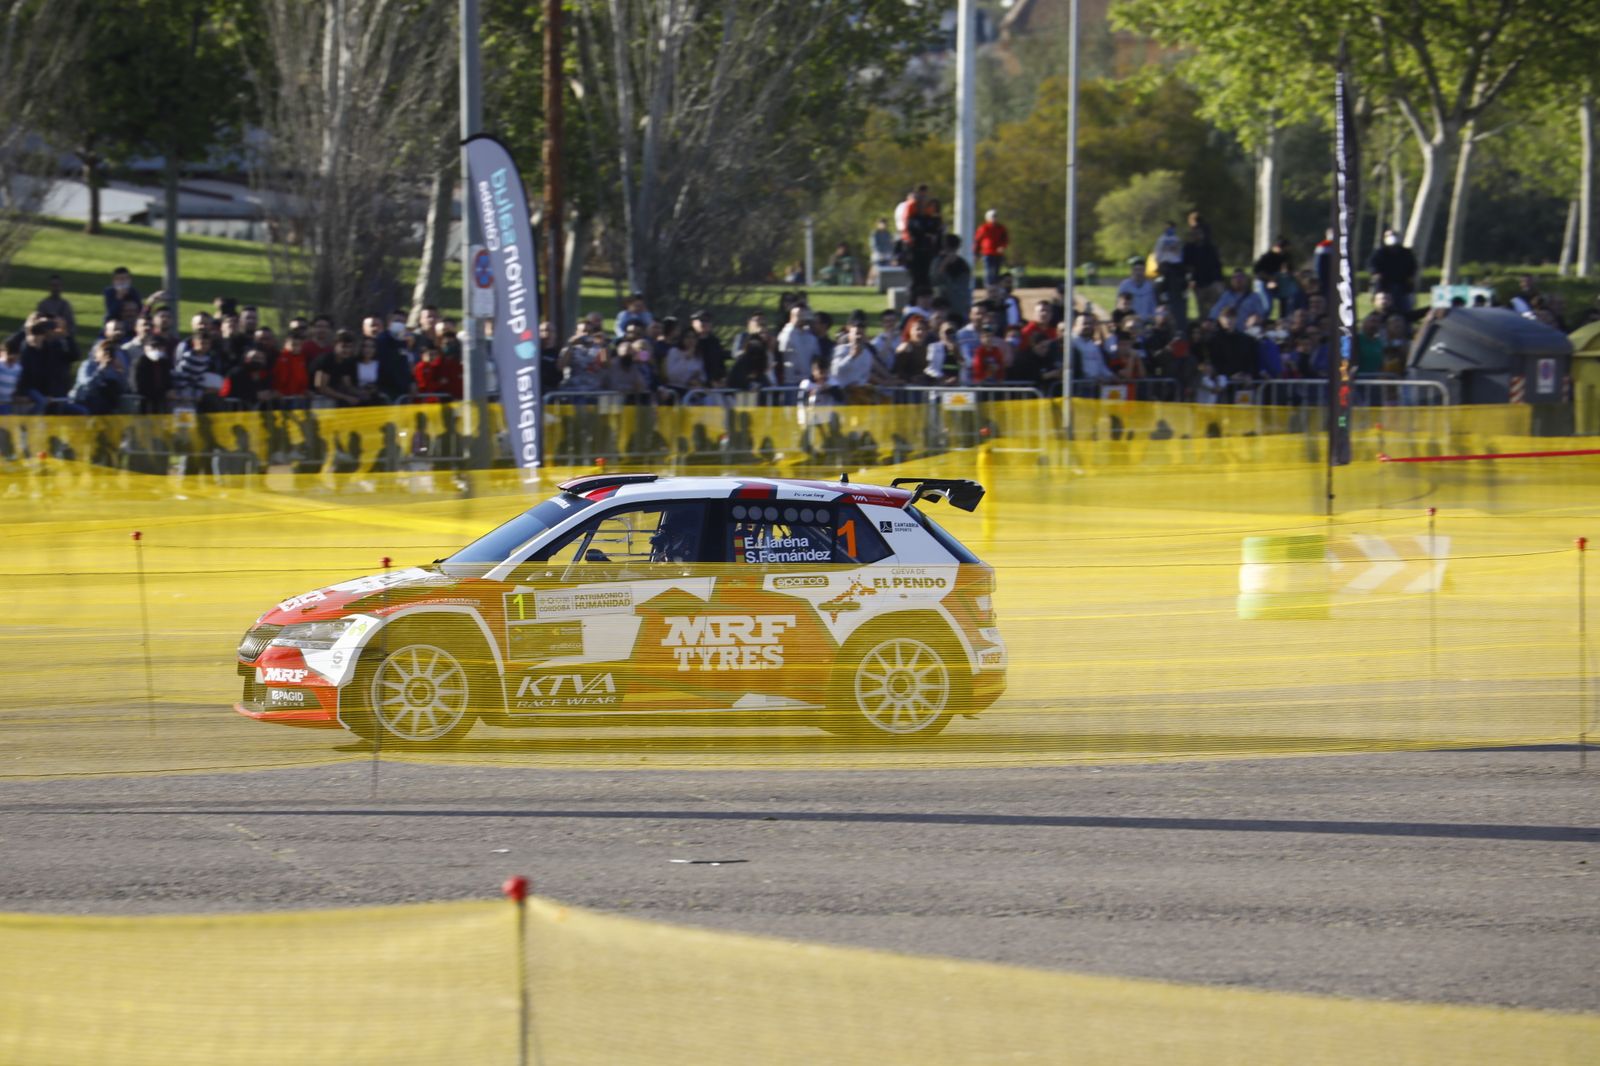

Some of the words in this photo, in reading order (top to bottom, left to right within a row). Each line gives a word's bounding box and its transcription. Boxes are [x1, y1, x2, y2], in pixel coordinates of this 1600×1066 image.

[837, 520, 858, 558] 1
[745, 548, 831, 563] S.Fernández
[776, 576, 825, 587] sparco
[872, 577, 891, 589] EL
[892, 577, 947, 589] PENDO
[574, 592, 624, 601] PATRIMONIO
[513, 593, 525, 620] 1
[575, 599, 631, 610] HUMANIDAD
[661, 614, 796, 647] MRF
[673, 644, 784, 673] TYRES
[264, 667, 309, 683] MRF
[516, 673, 616, 698] KTVA
[516, 699, 561, 708] RACE
[567, 696, 616, 706] WEAR
